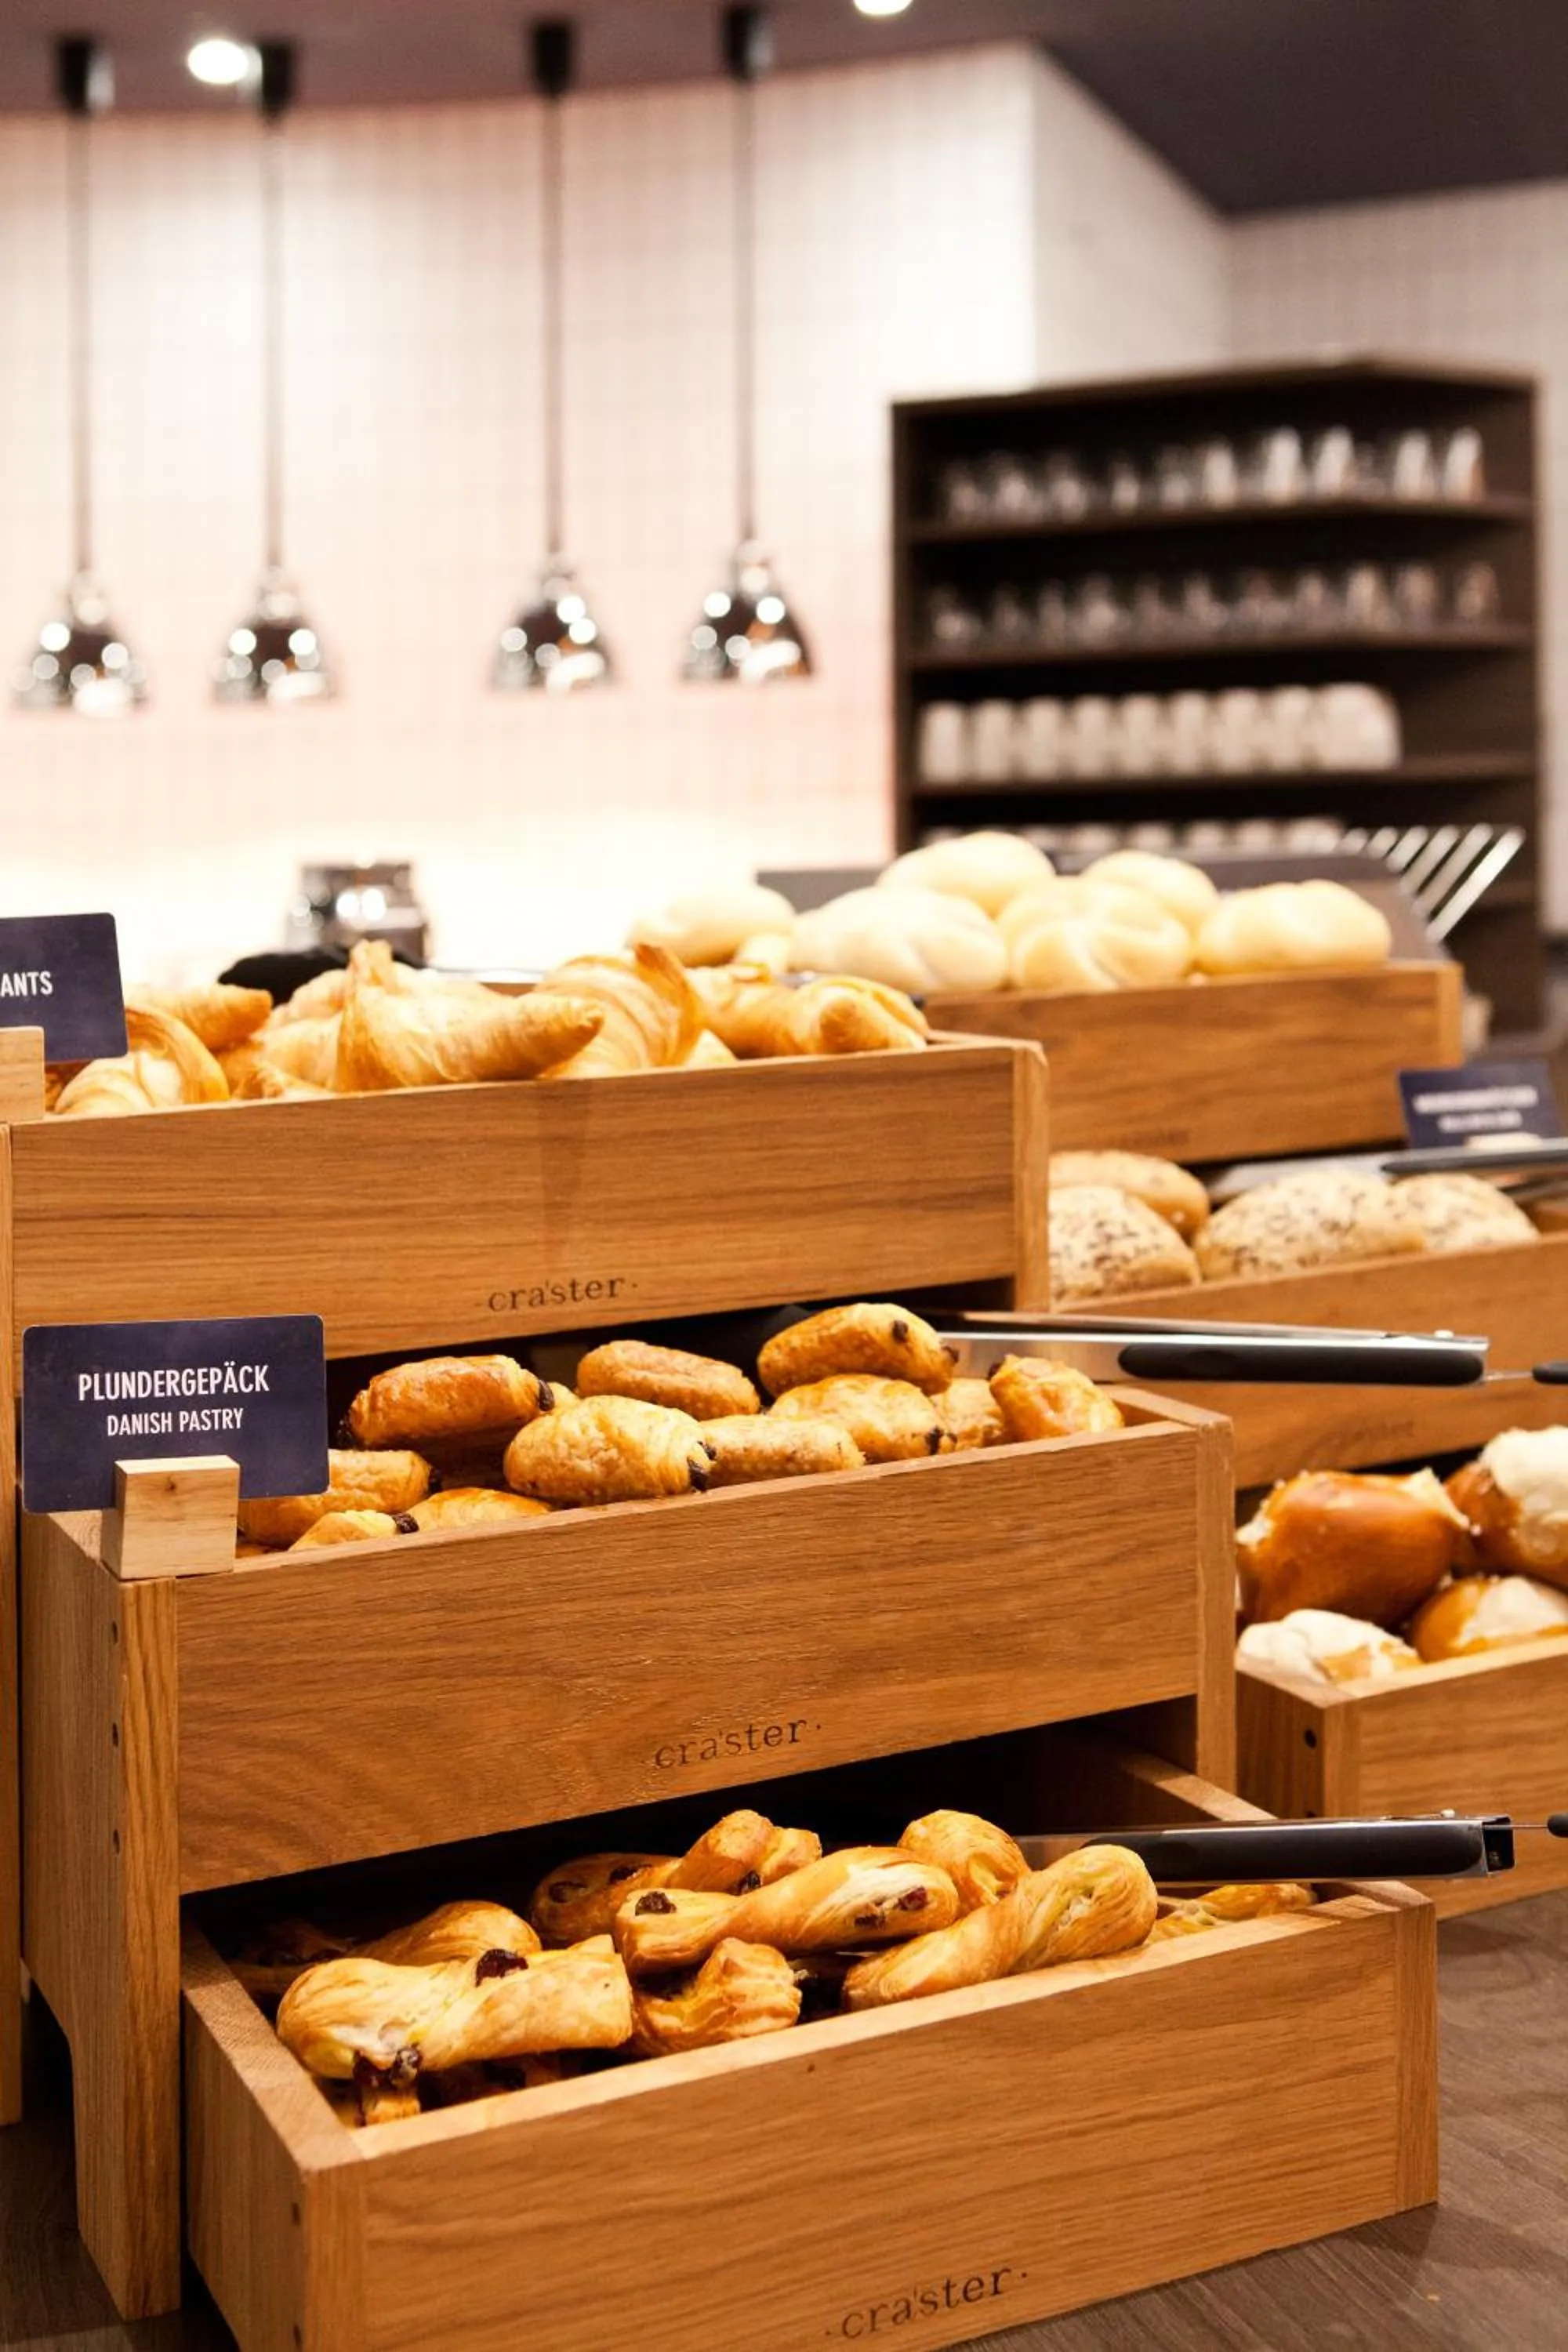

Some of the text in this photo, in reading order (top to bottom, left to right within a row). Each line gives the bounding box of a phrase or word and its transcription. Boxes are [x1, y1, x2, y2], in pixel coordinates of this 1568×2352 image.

[78, 1361, 270, 1402] PLUNDERGEPÄCK
[107, 1407, 245, 1437] DANISH PASTRY
